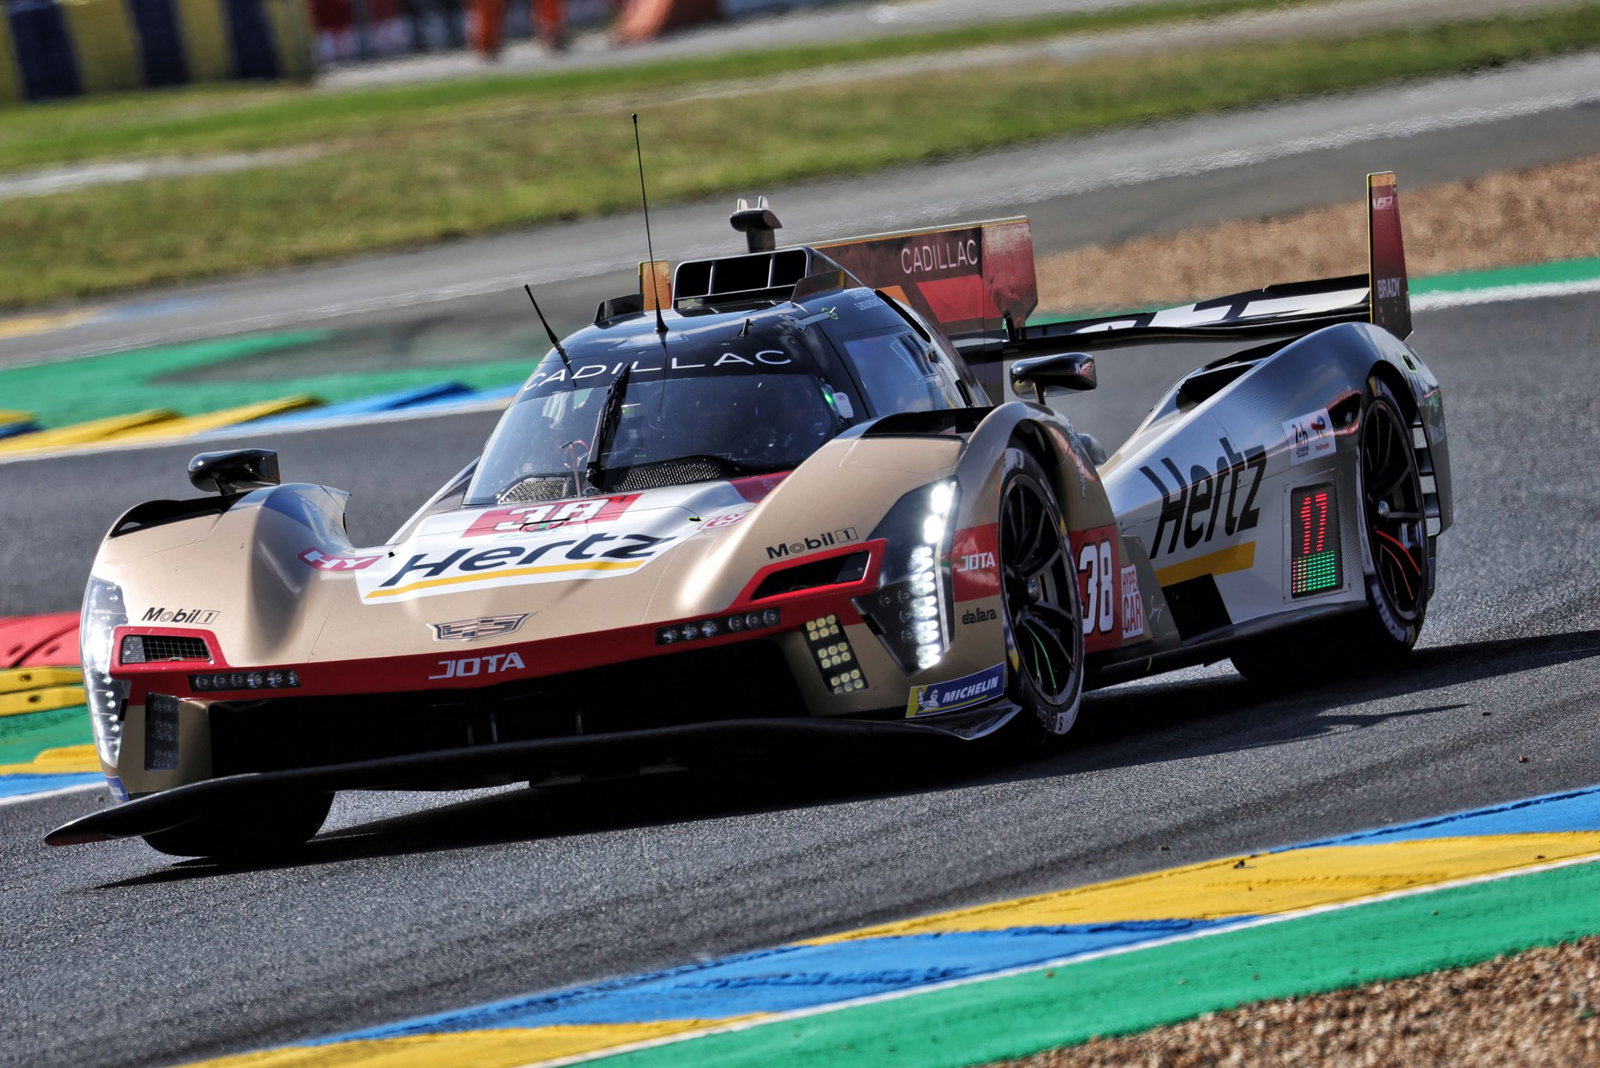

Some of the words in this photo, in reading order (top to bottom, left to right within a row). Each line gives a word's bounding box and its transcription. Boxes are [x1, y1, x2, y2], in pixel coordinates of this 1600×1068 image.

[901, 239, 978, 274] CADILLAC
[1377, 277, 1400, 299] BRADY
[523, 350, 792, 391] CADILLAC
[1138, 436, 1267, 560] Hertz
[765, 532, 835, 559] Mobil
[304, 550, 376, 569] HY
[378, 532, 679, 588] Hertz
[957, 552, 996, 572] JOTA
[1079, 540, 1114, 634] 38
[141, 607, 202, 624] Mobil
[962, 607, 998, 625] dallara
[1122, 593, 1143, 633] CAR
[428, 652, 526, 680] JOTA
[942, 676, 999, 703] MICHELIN
